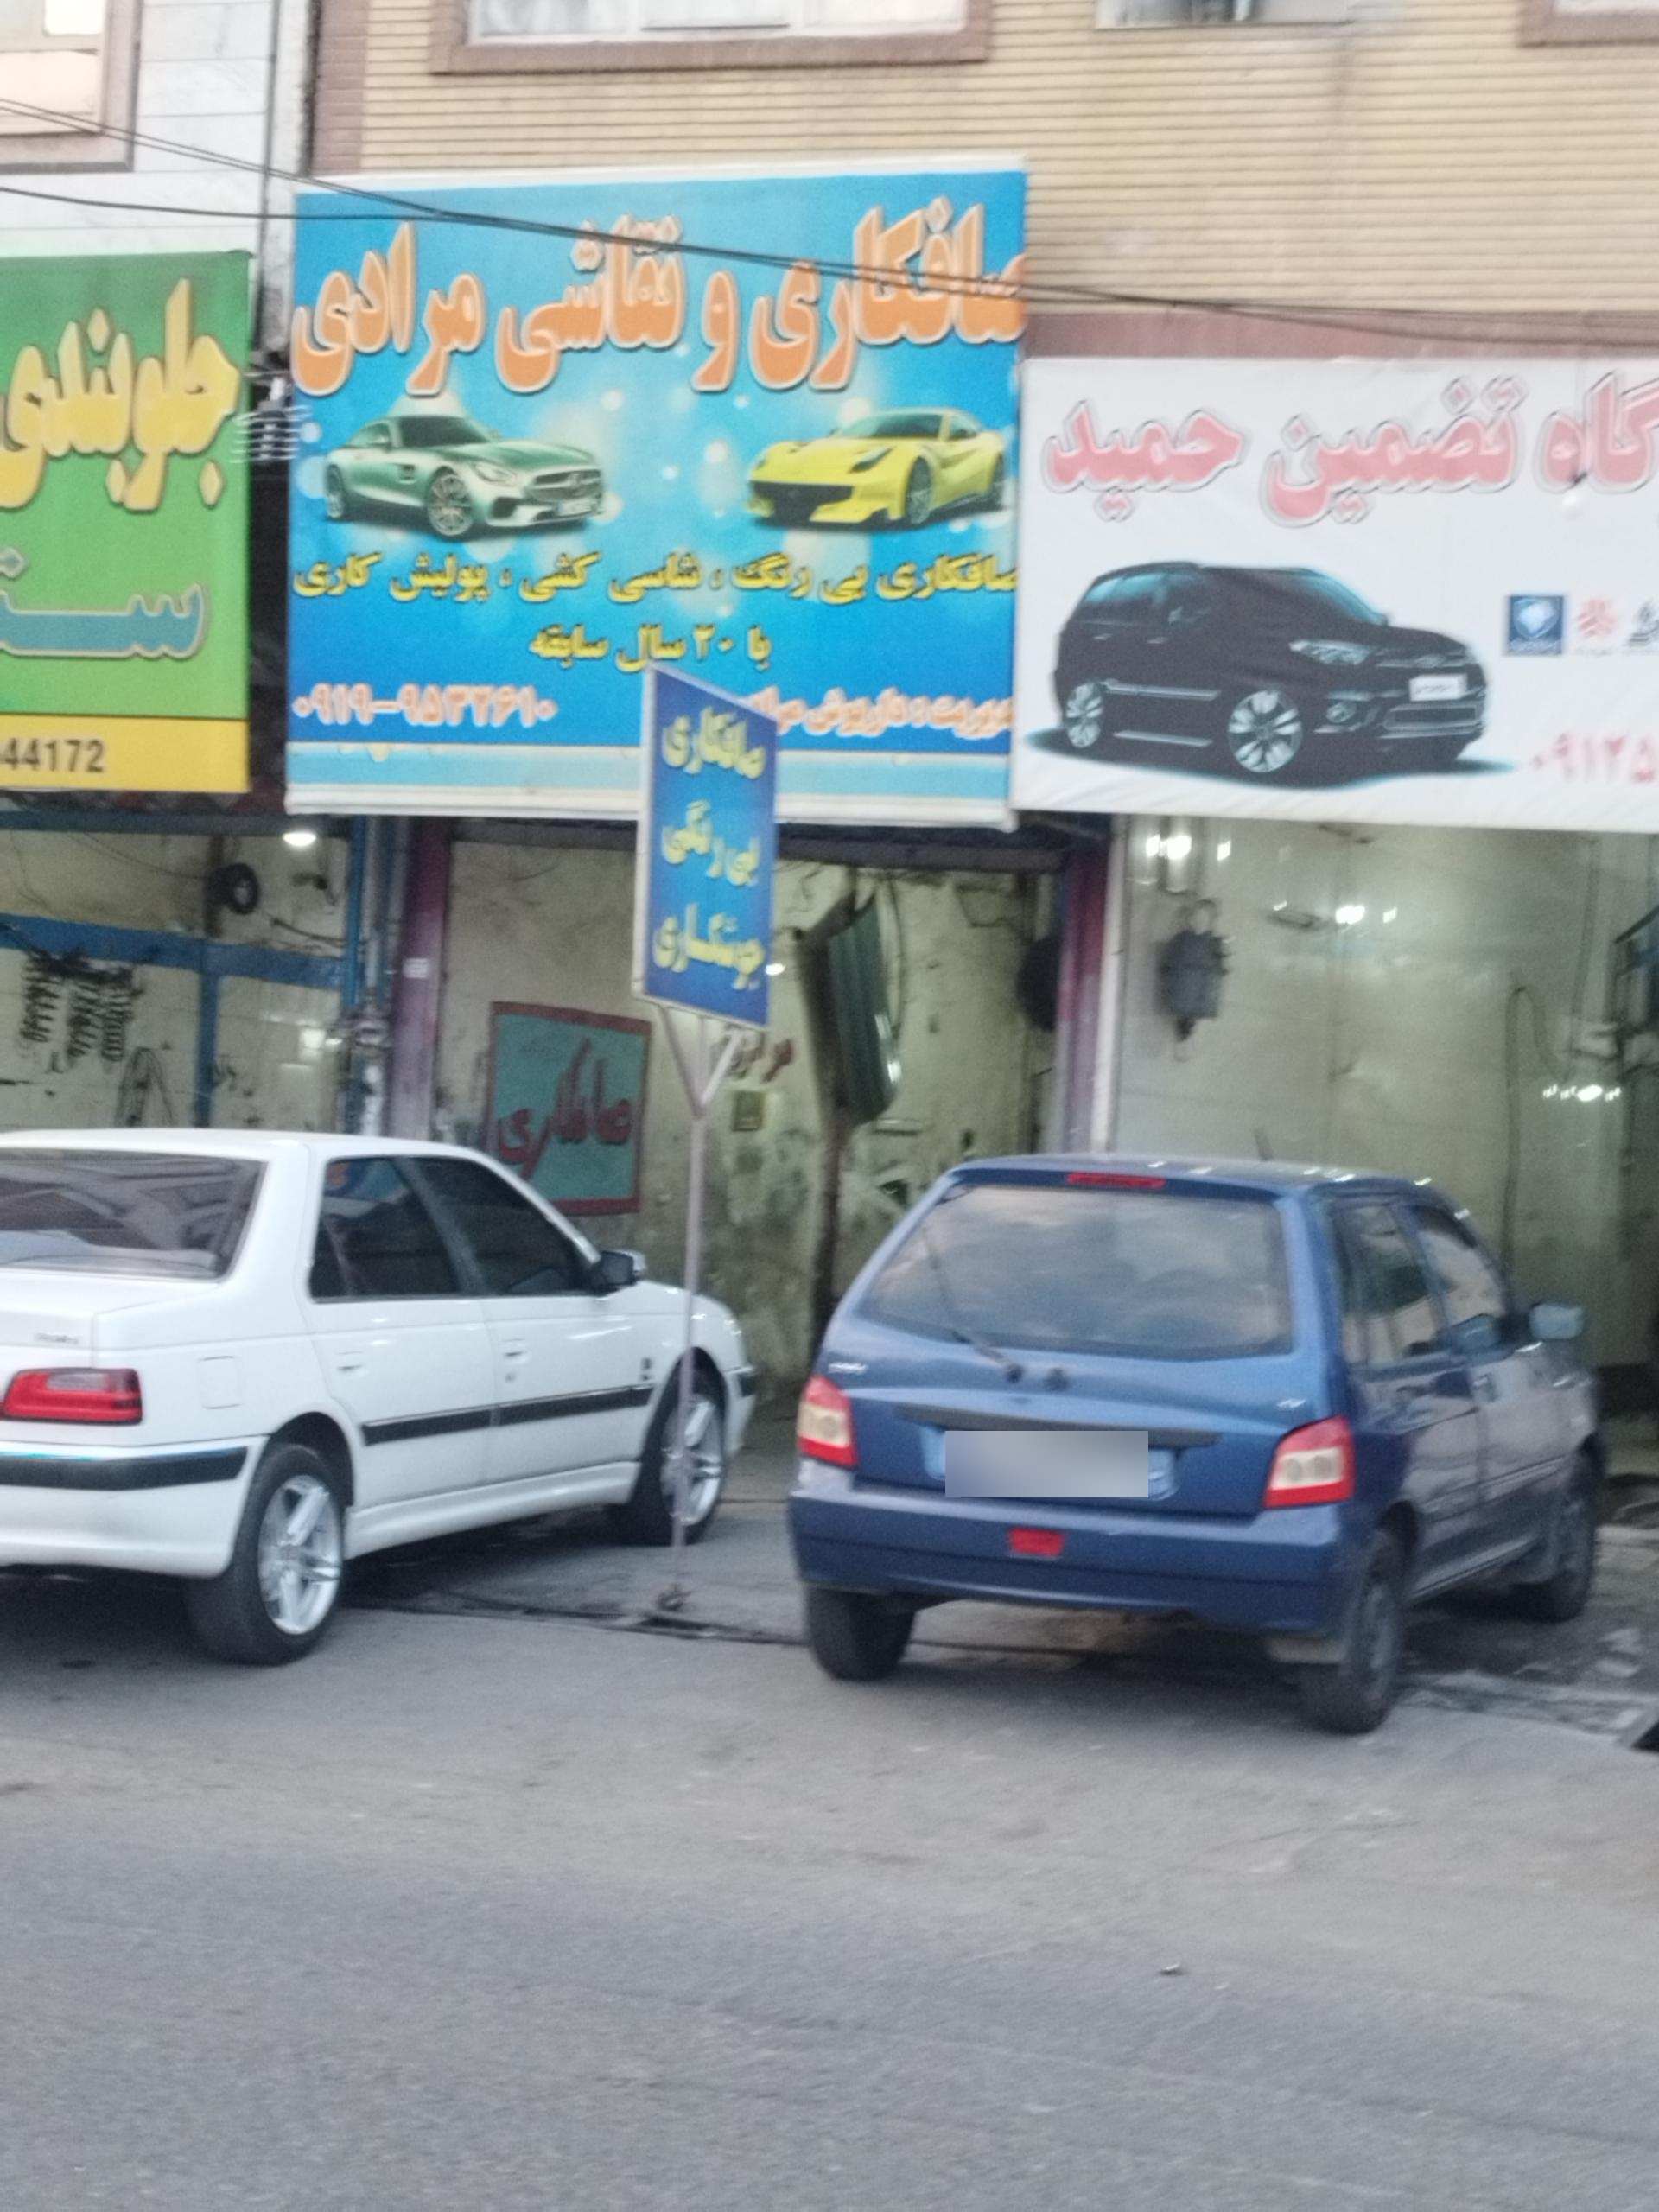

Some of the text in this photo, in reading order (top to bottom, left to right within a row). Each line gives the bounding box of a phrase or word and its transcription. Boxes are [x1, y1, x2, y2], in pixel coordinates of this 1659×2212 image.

[289, 219, 486, 397] مرادی
[495, 212, 685, 393] نقاشی
[690, 270, 741, 391] و
[1042, 368, 1659, 529] گاه تضمین حمید
[529, 623, 772, 672] با ۲۰ سال سابقه
[819, 566, 868, 604] بی
